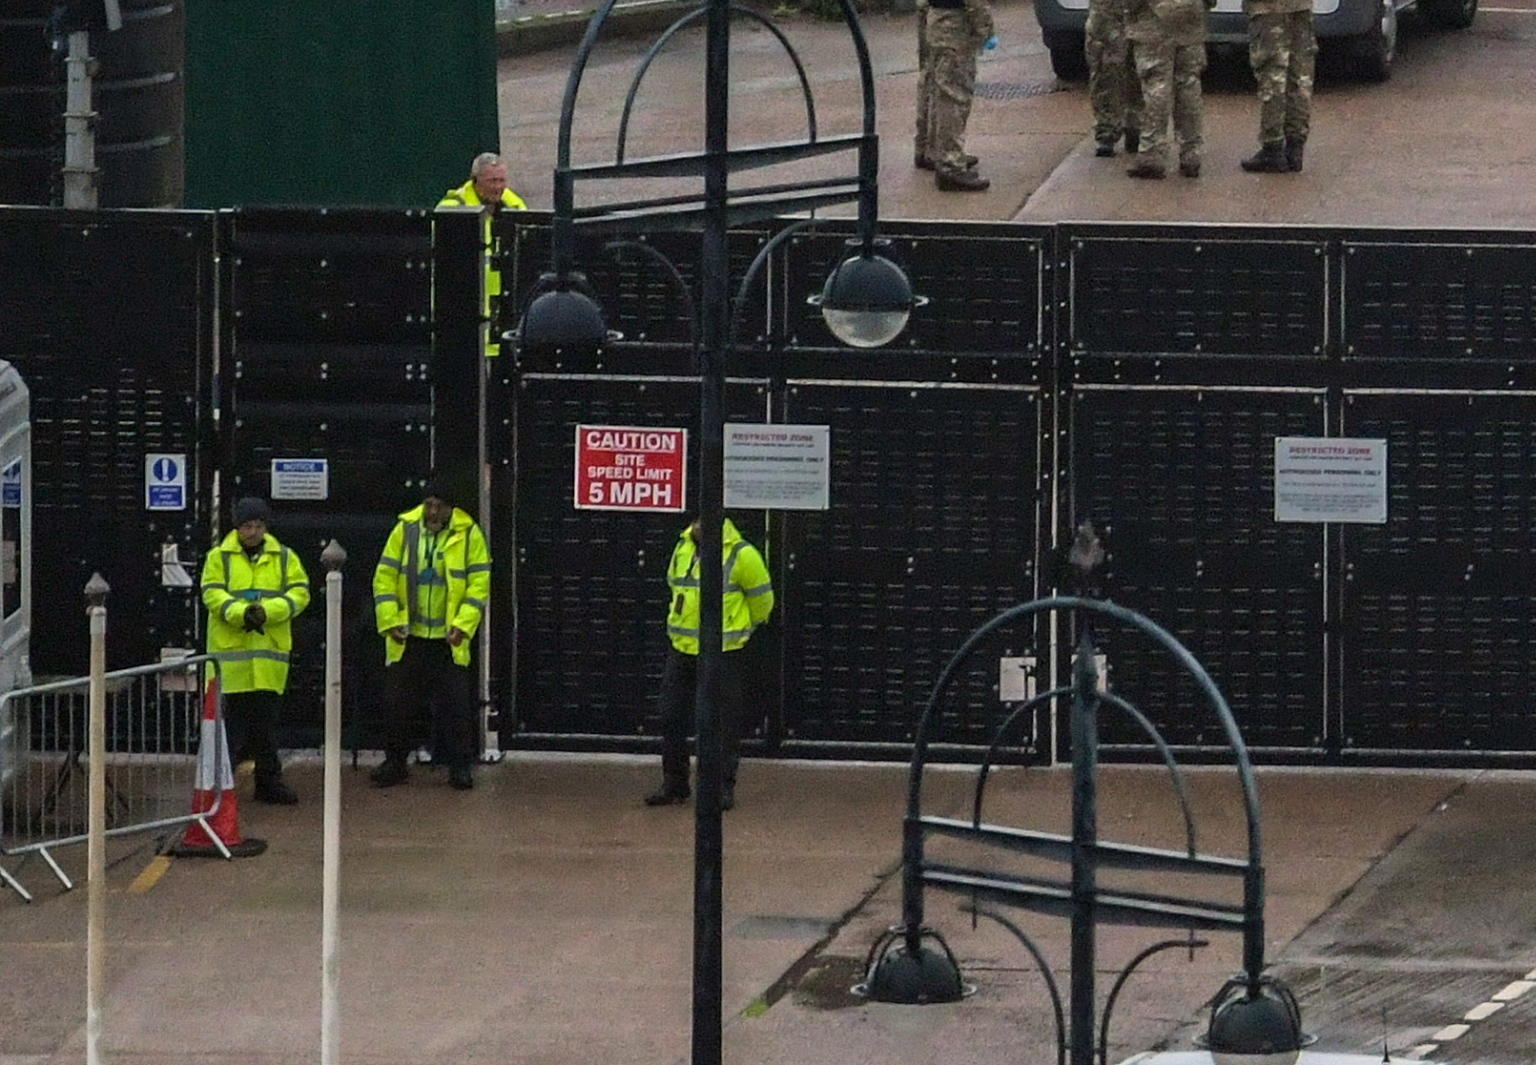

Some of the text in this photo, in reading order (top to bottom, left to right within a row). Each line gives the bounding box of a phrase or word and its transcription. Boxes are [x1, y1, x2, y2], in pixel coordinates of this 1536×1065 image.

[587, 431, 676, 450] CAUTION
[615, 454, 645, 466] SITE
[587, 467, 672, 481] SPEED LIMIT
[589, 482, 672, 505] 5 MPH
